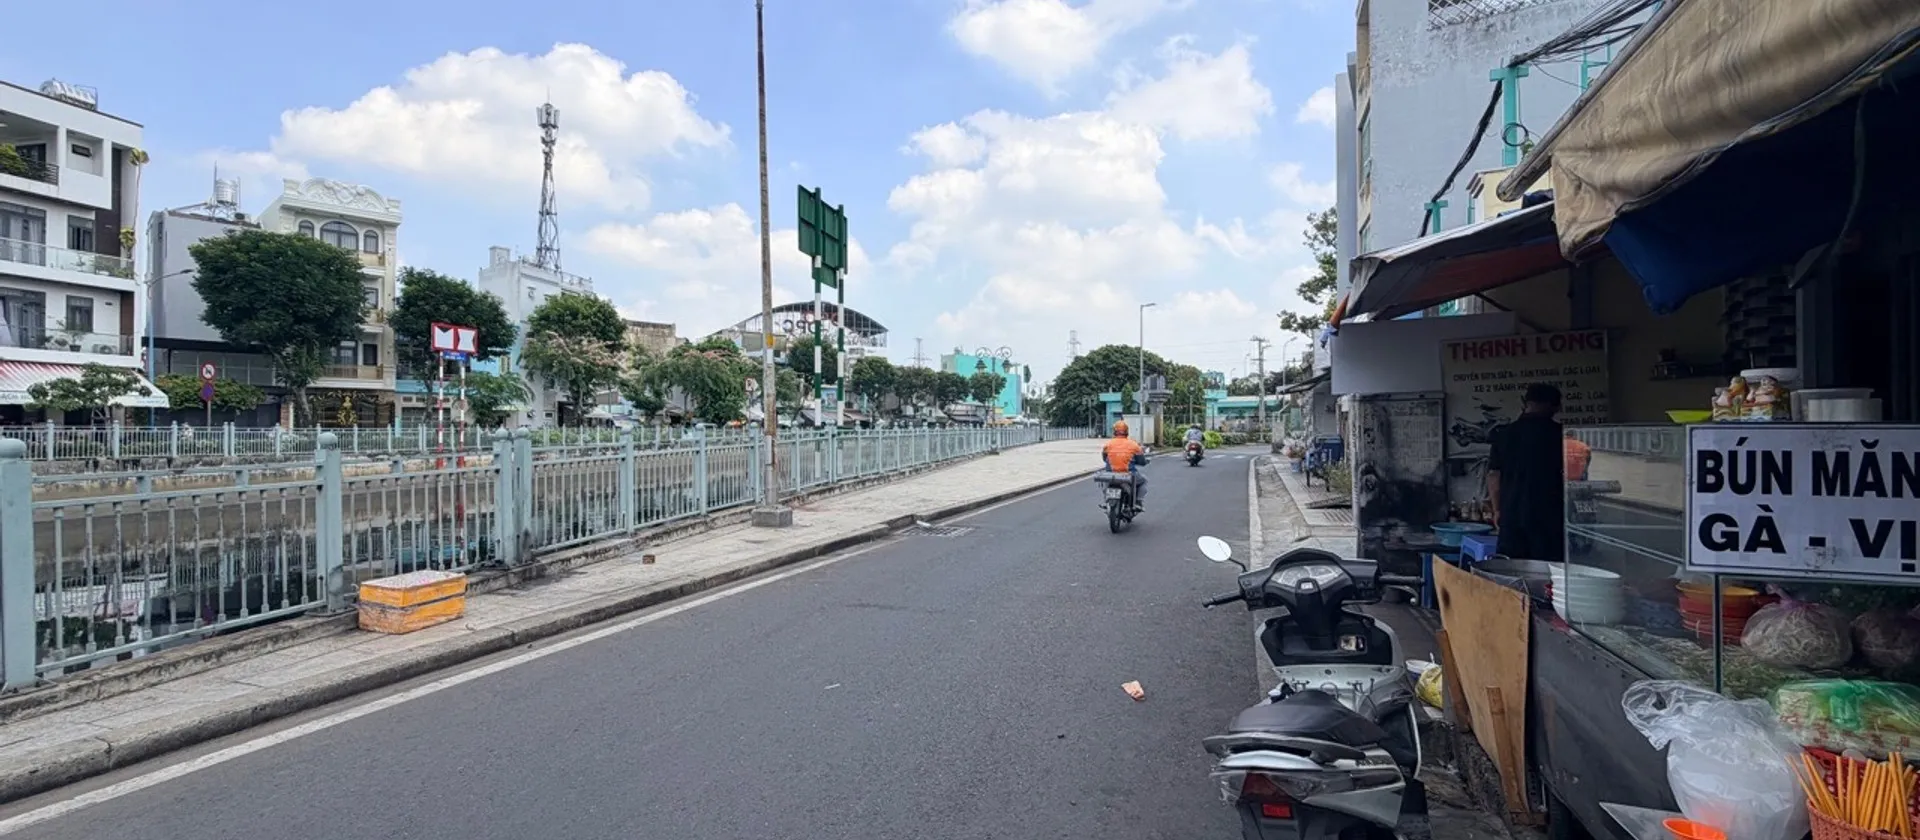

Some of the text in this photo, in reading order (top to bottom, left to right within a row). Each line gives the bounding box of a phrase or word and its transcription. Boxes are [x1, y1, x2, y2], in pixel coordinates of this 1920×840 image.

[1448, 331, 1604, 360] THANH LONG
[1696, 436, 1920, 499] BÚN MĂN
[1698, 504, 1787, 554] GÀ
[1848, 518, 1917, 572] VỊ
